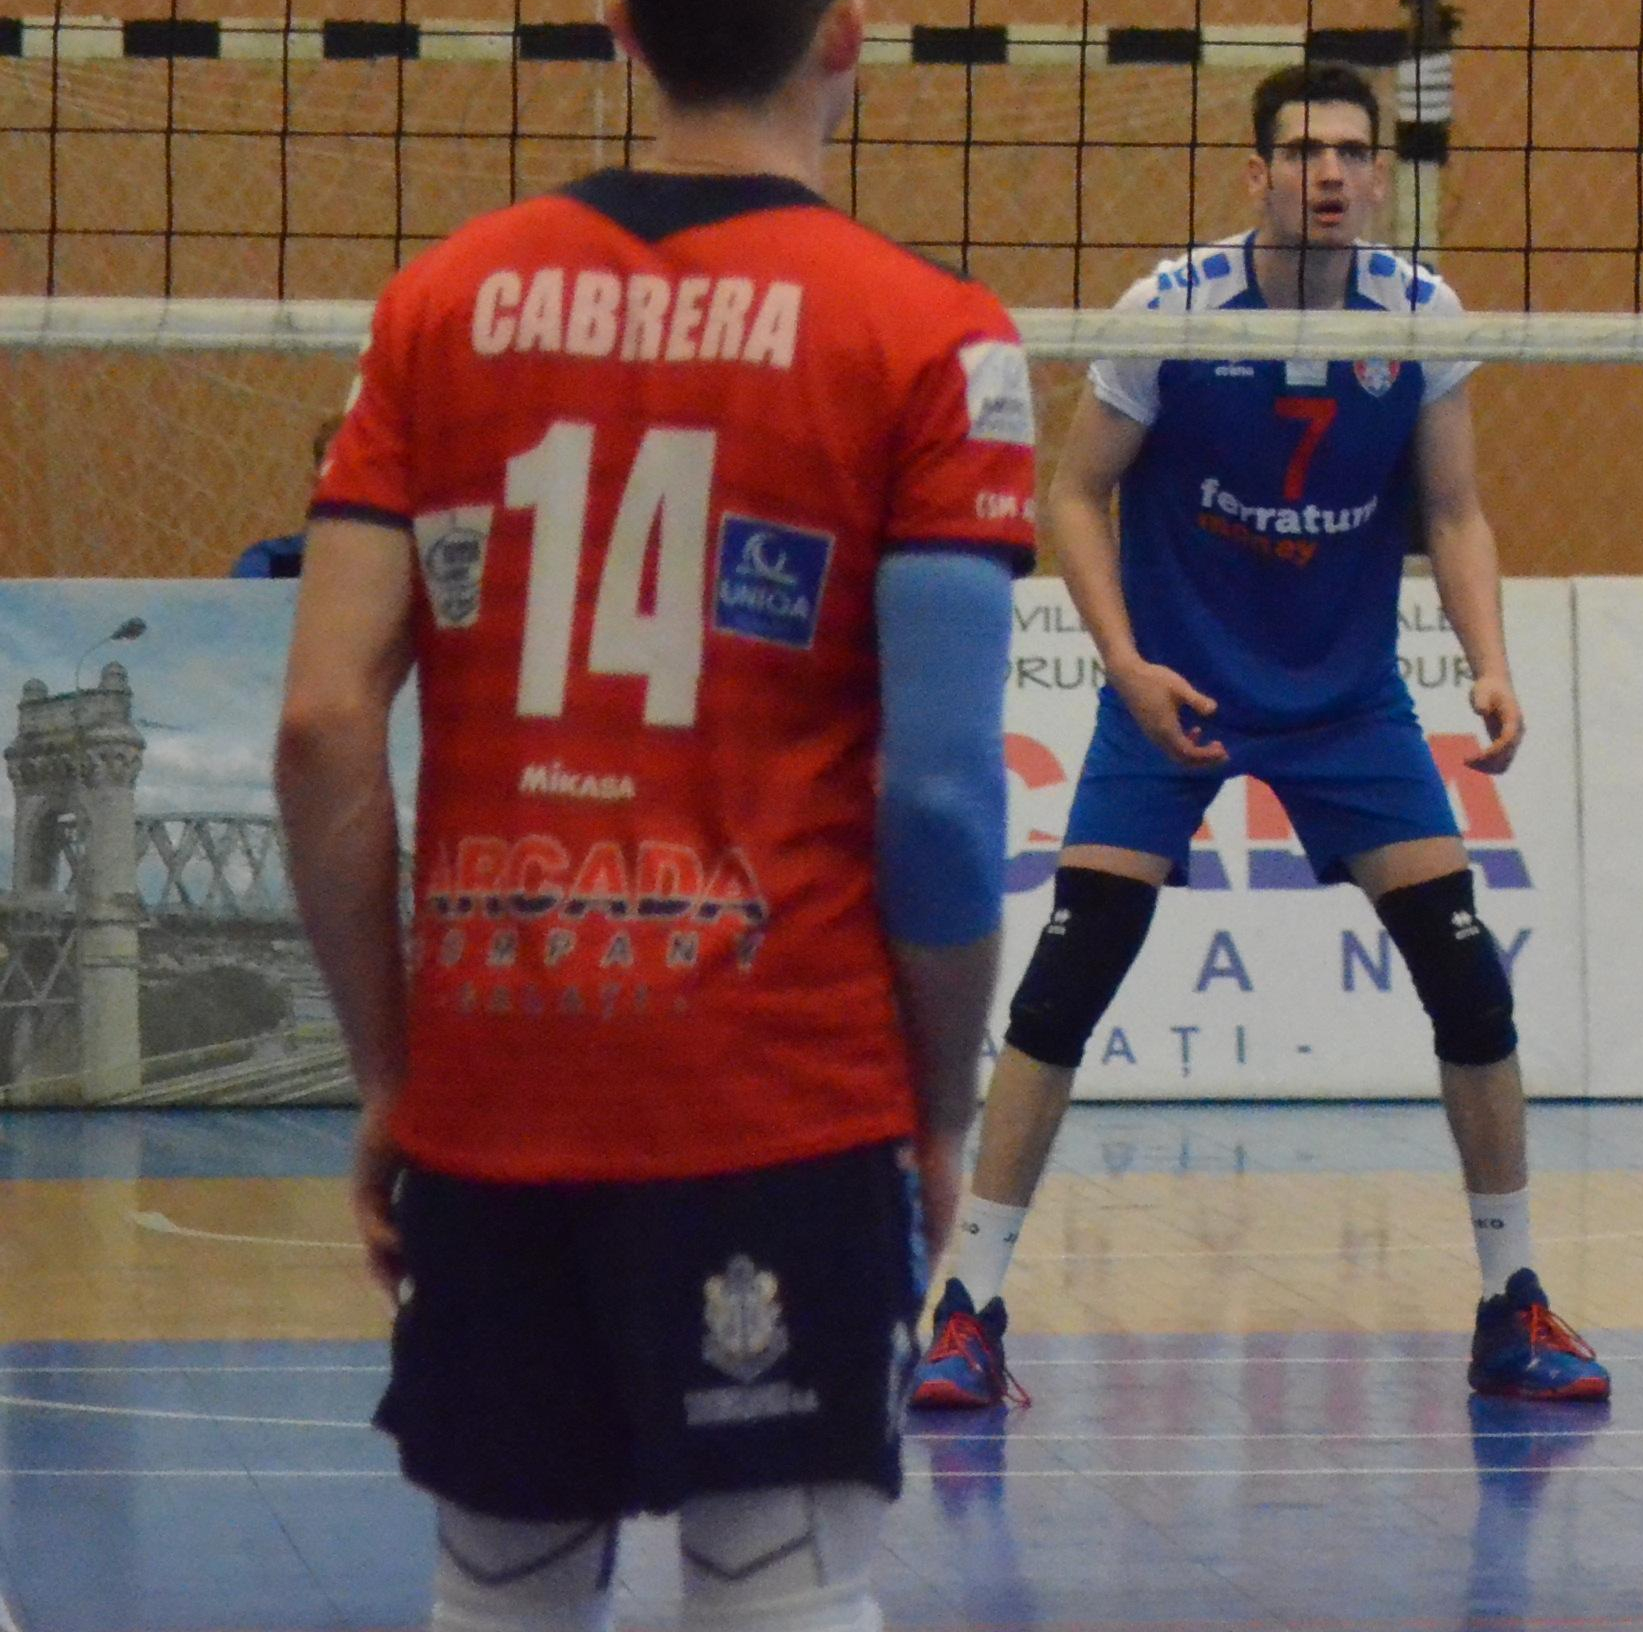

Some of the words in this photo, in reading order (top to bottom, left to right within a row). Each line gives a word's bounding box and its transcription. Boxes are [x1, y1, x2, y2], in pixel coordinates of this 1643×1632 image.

[472, 268, 802, 369] CABRERA
[1274, 397, 1338, 504] 7
[505, 420, 717, 727] 14
